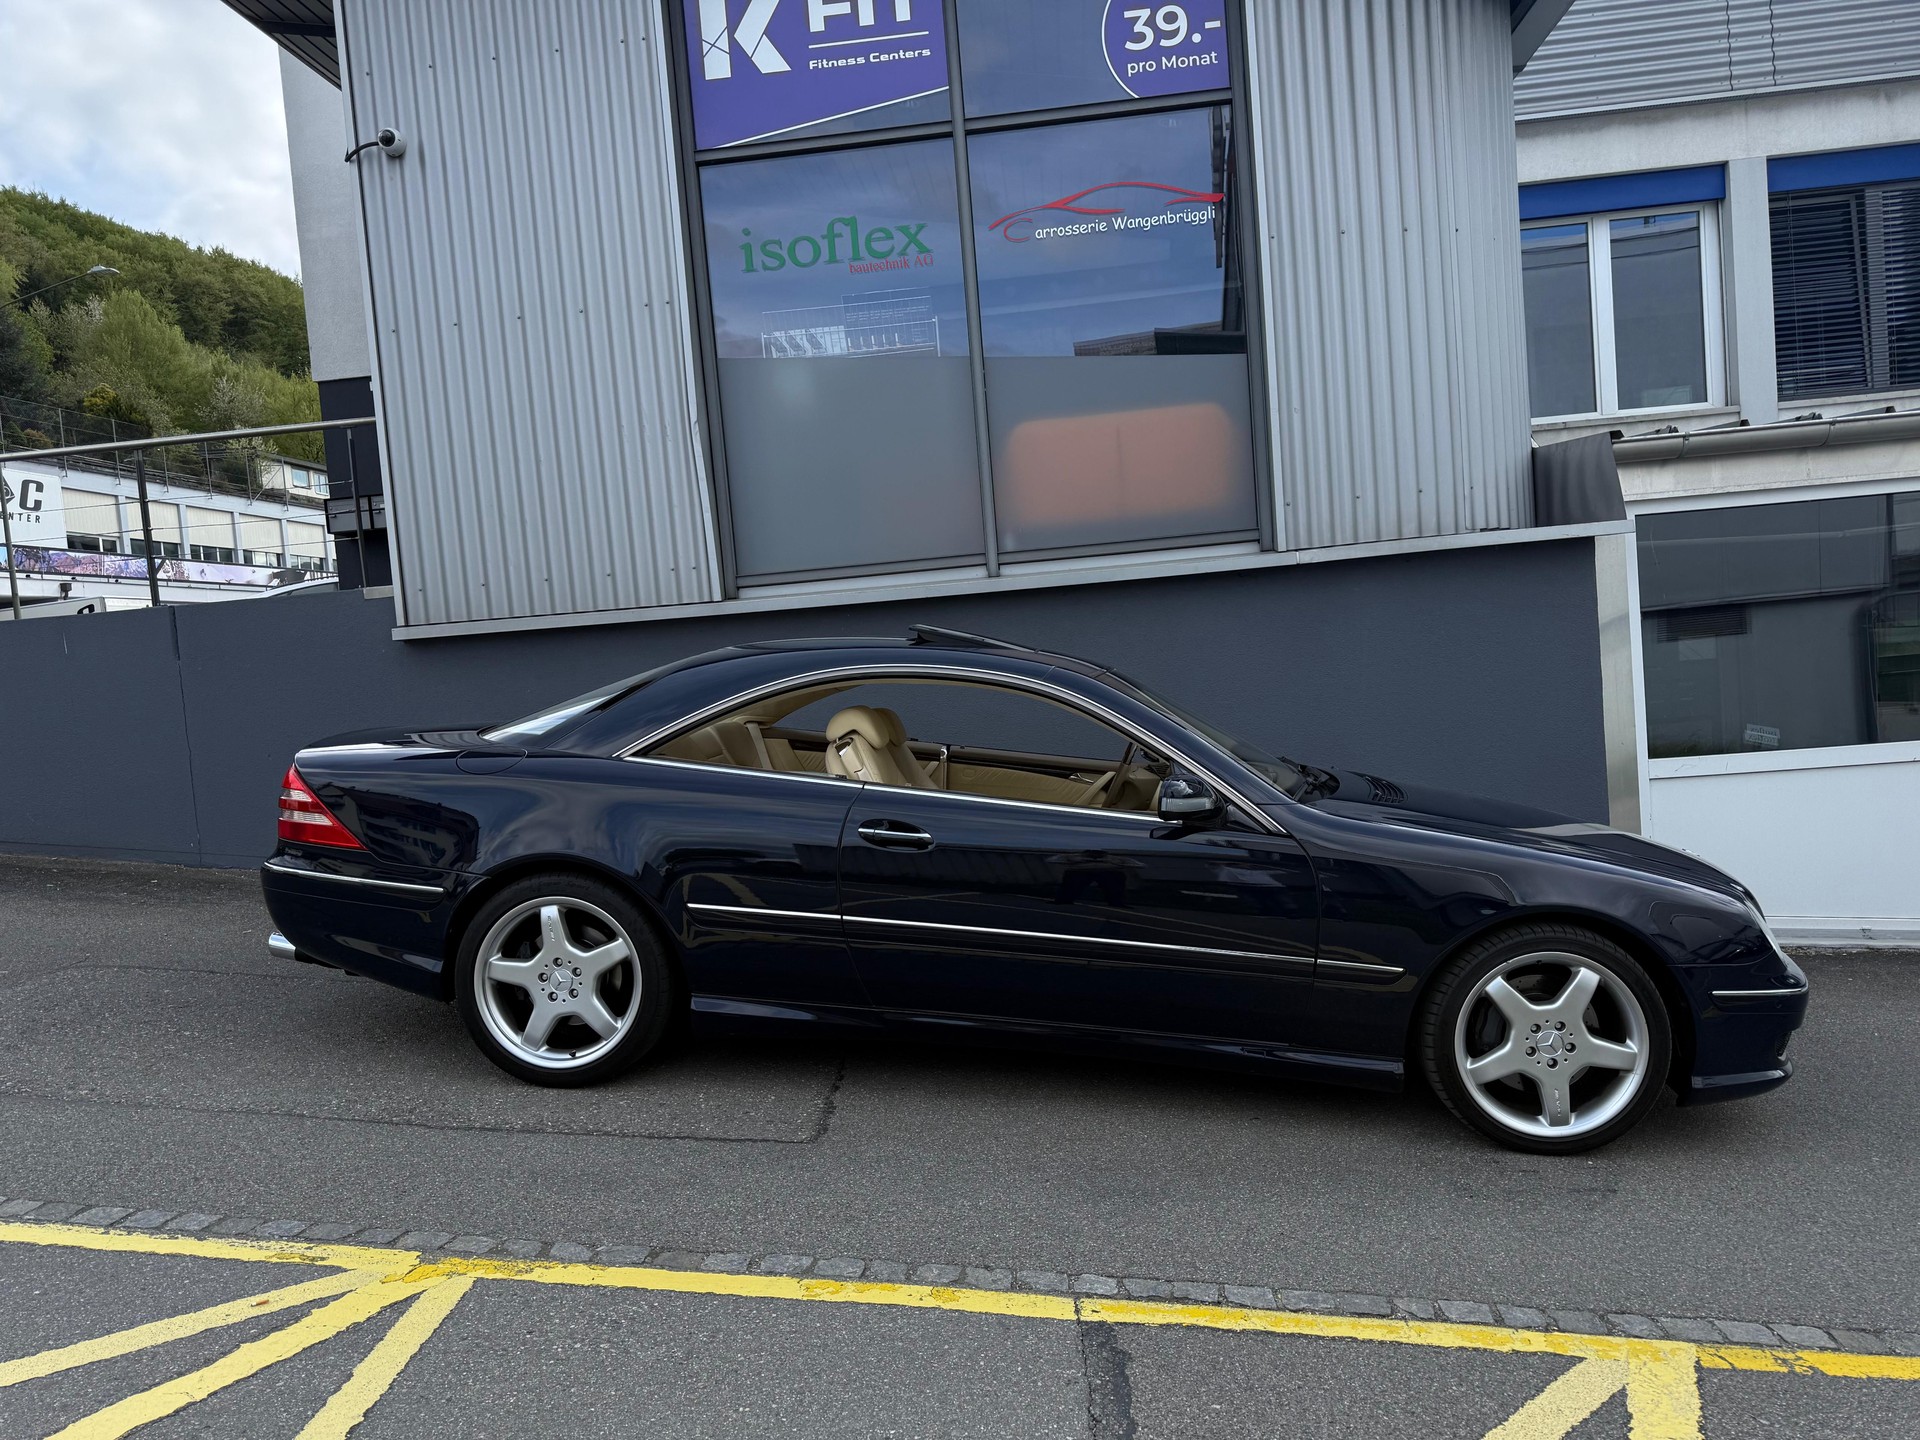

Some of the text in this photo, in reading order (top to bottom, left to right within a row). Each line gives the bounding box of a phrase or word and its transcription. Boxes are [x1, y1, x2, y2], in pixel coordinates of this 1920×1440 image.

[1123, 5, 1221, 51] 39.-
[809, 48, 931, 70] Fitness Centers
[1127, 51, 1218, 77] pro Monat
[1111, 205, 1216, 233] Wangenbrüggli
[739, 215, 934, 273] isoflex
